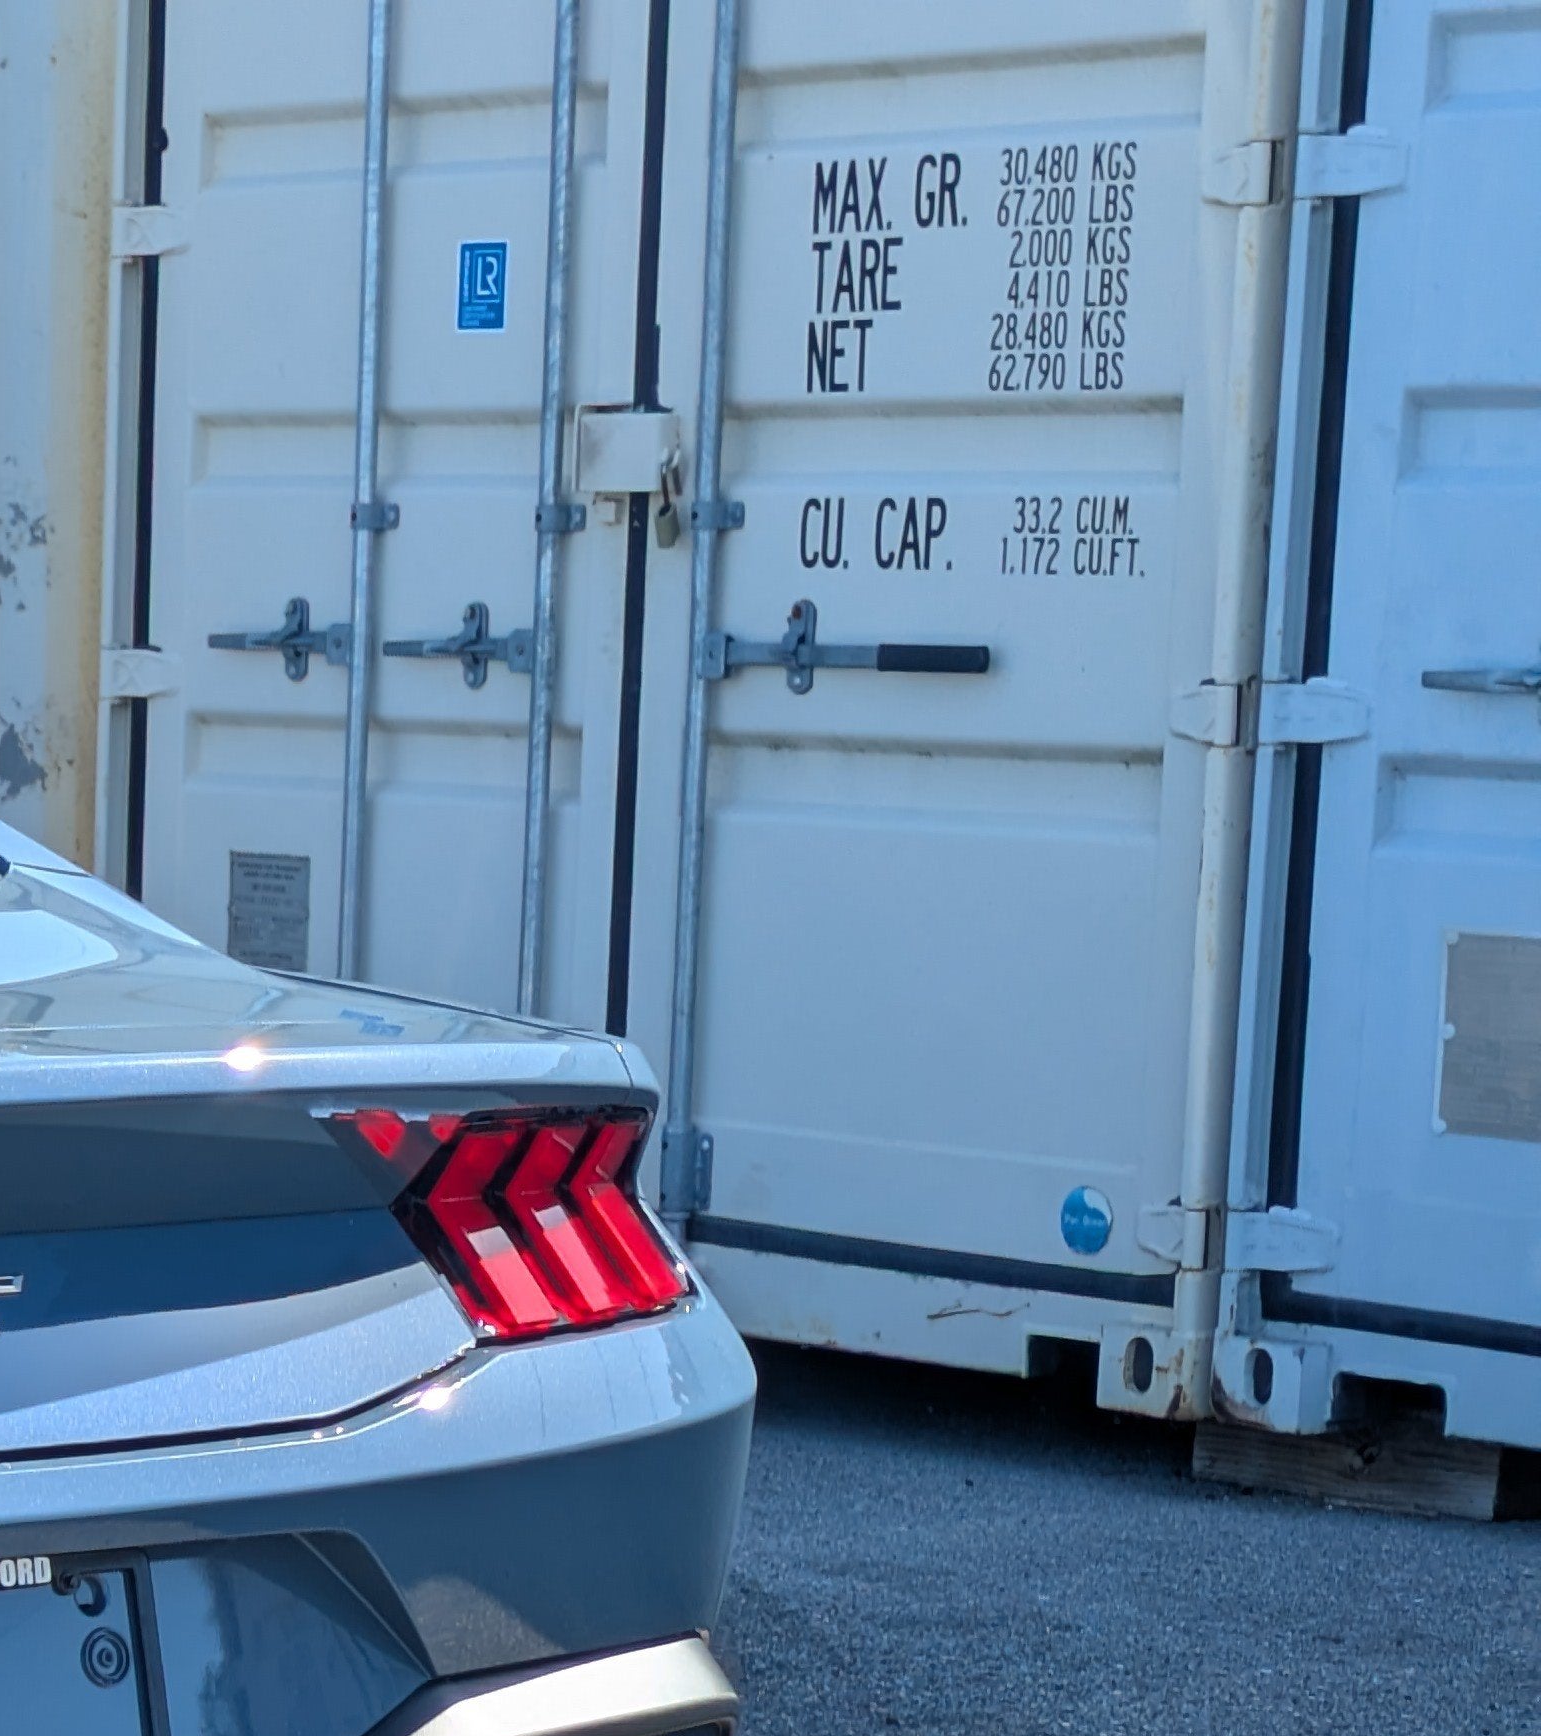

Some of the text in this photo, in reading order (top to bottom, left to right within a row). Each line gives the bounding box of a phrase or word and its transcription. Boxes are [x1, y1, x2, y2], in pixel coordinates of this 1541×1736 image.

[1000, 141, 1137, 186] 30.480 KGS
[813, 152, 967, 234] MAX. GR.
[997, 184, 1134, 227] 67.200 LBS
[1009, 226, 1131, 268] 2.000 KGS
[812, 236, 903, 314] TARE
[1007, 267, 1129, 309] 4.410 LBS
[990, 308, 1126, 351] 28.480 KGS
[807, 319, 873, 393] NET
[989, 352, 1124, 391] 62.790 LBS
[800, 496, 952, 570] CU. CAP.
[1013, 496, 1062, 534] 33.2
[1001, 536, 1060, 575] 1.172
